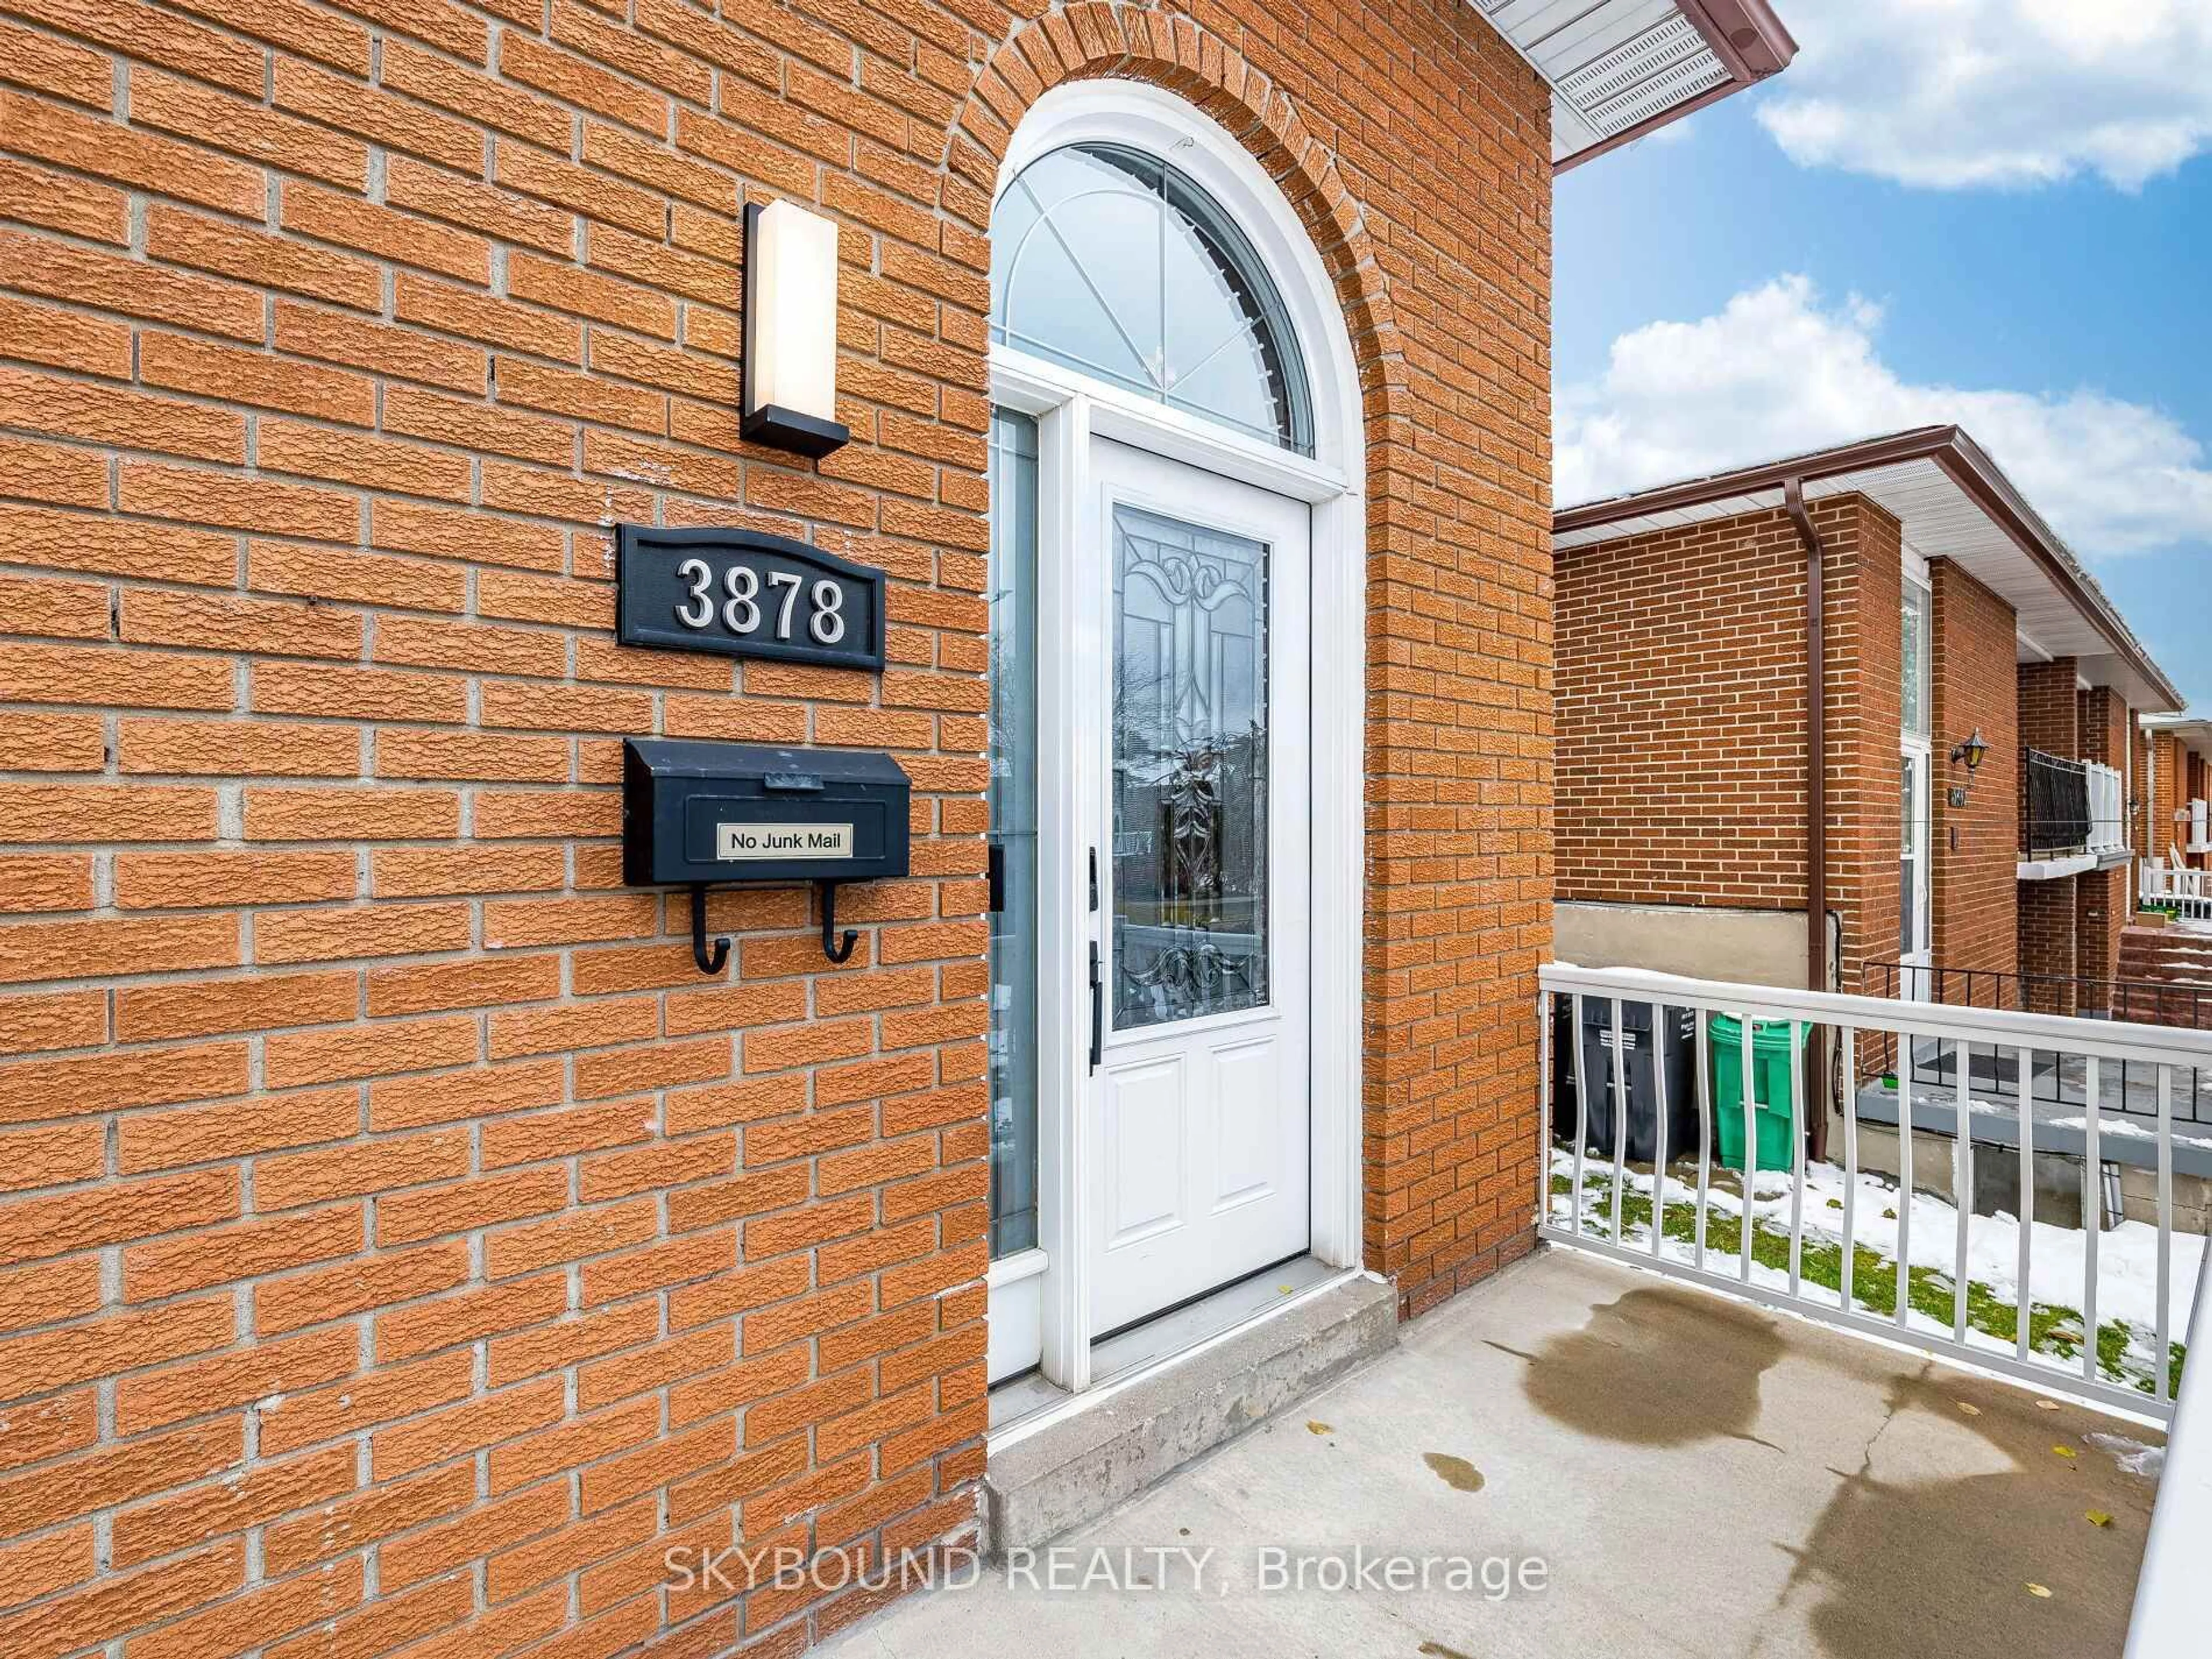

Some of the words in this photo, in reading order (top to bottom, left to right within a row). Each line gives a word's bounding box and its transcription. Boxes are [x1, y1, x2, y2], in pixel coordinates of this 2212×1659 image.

[675, 558, 845, 645] 3878
[731, 833, 757, 849] No
[762, 833, 803, 849] Junk
[808, 833, 840, 849] Mail
